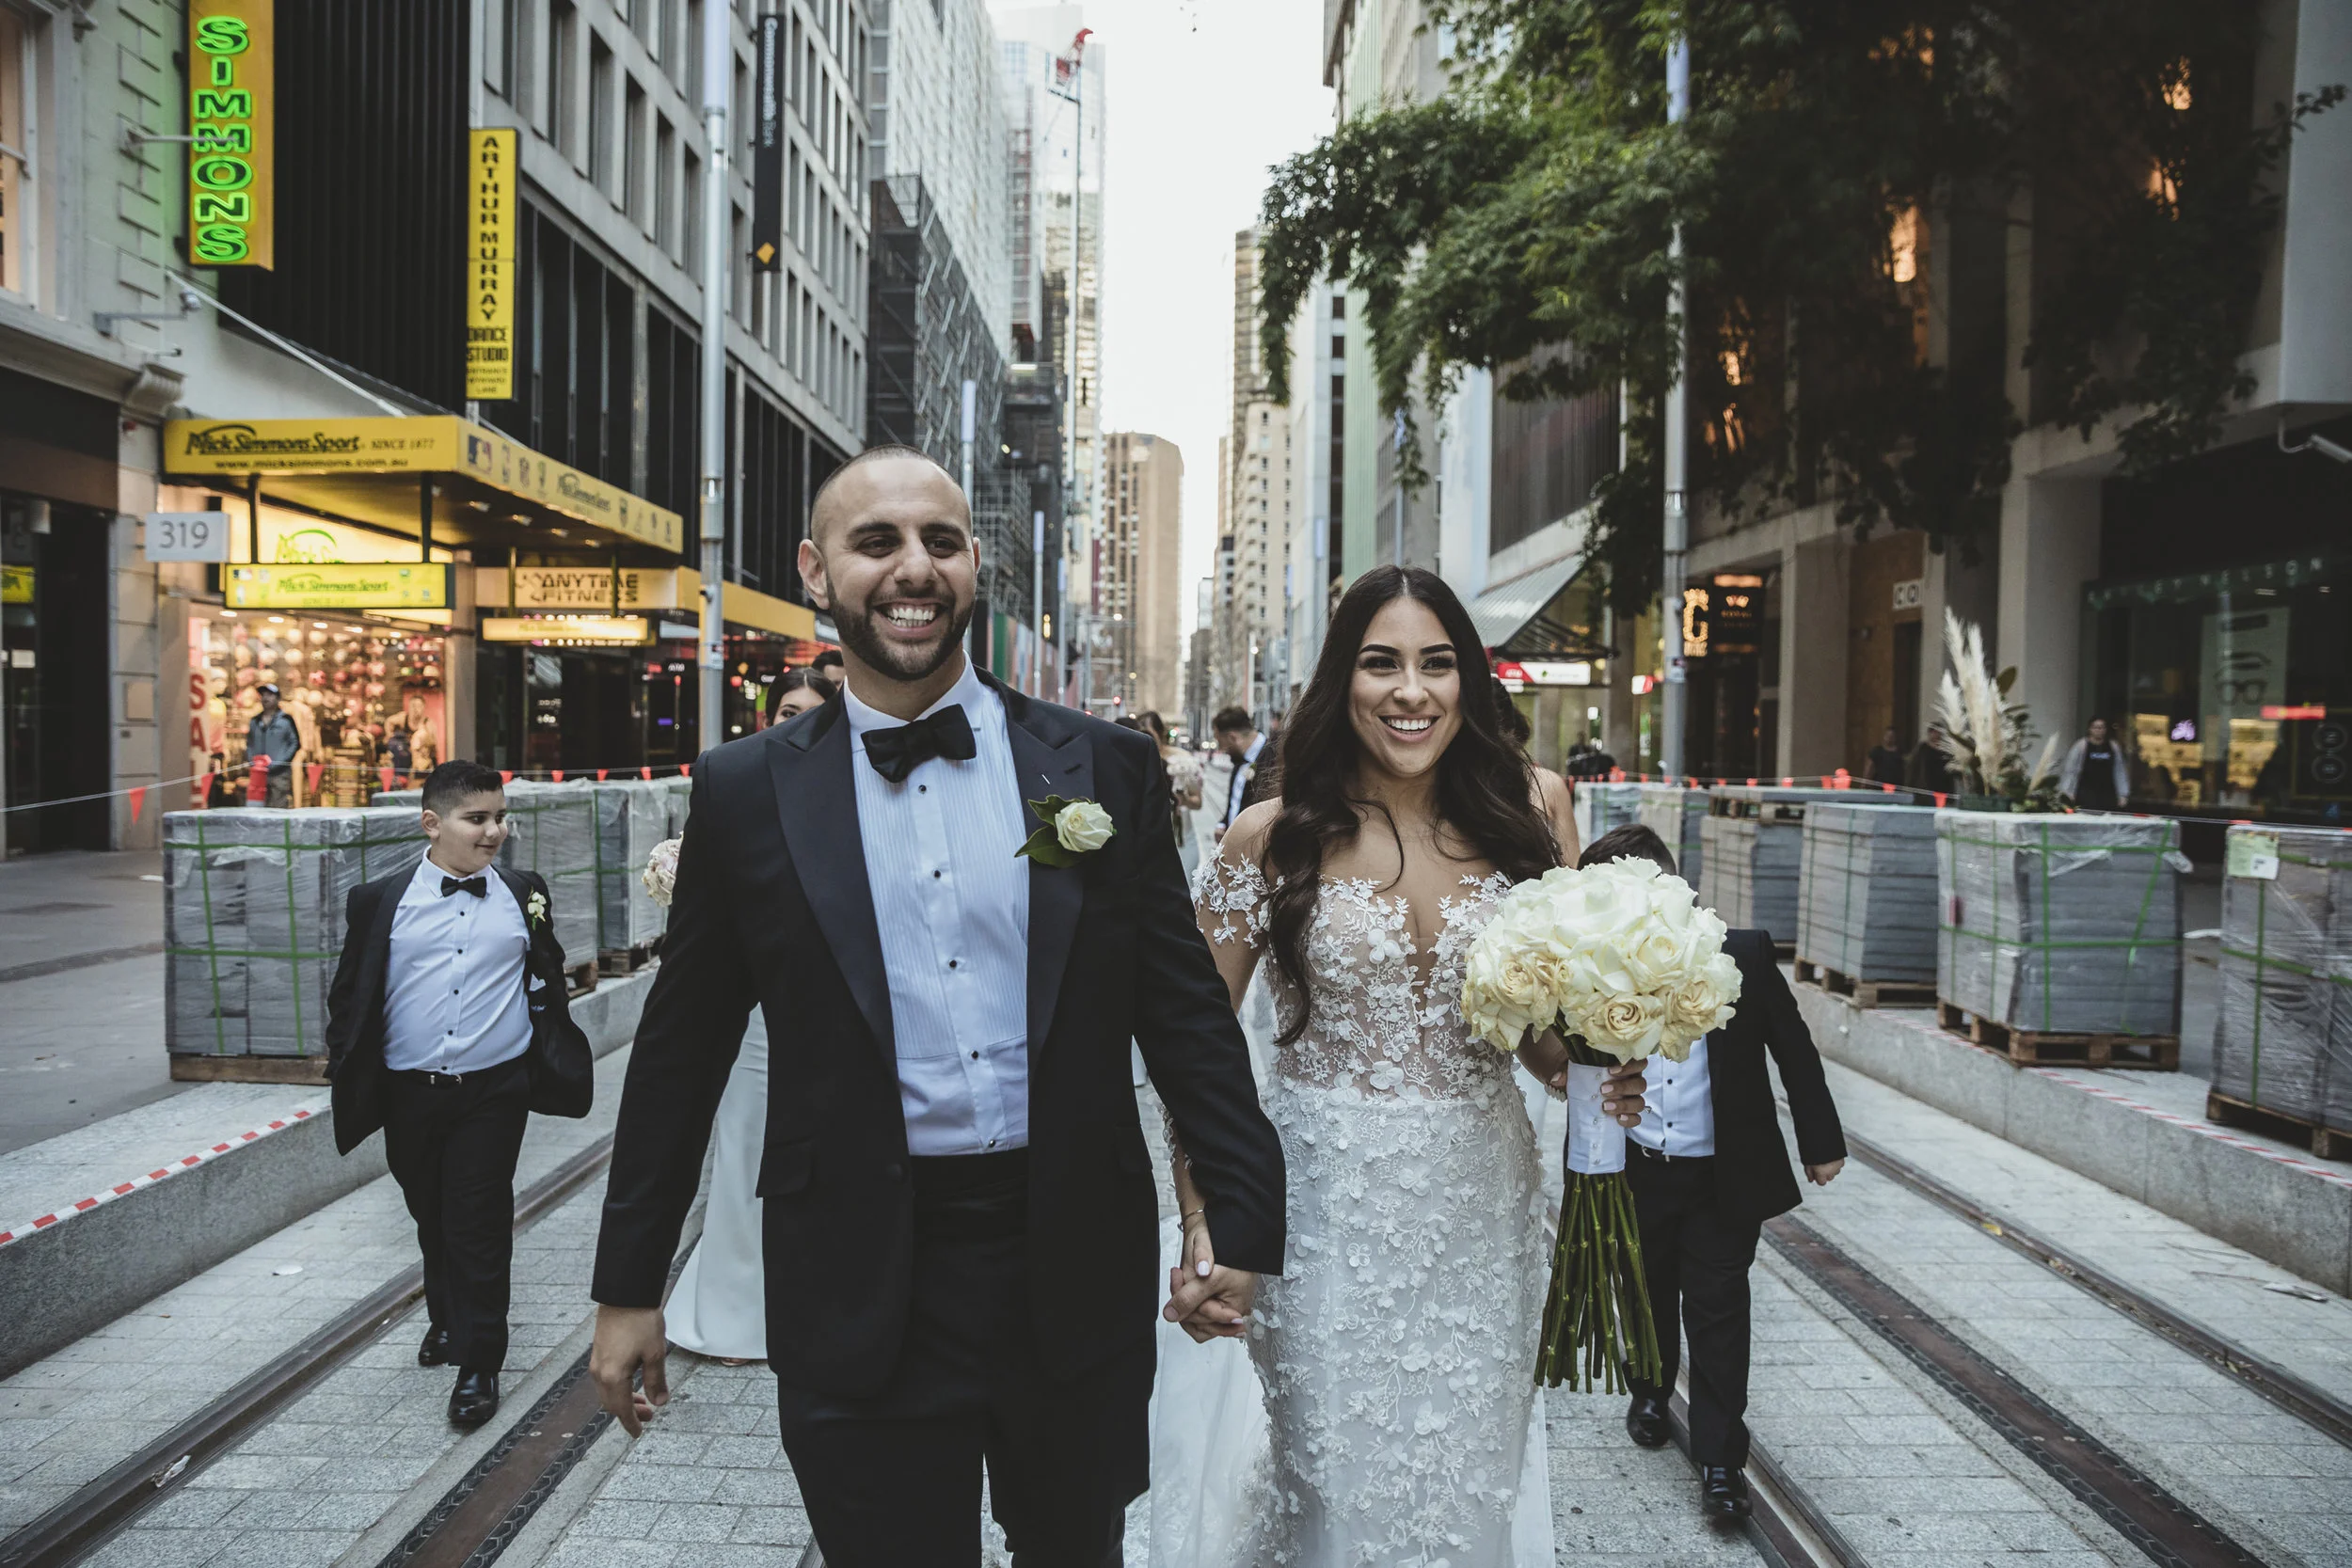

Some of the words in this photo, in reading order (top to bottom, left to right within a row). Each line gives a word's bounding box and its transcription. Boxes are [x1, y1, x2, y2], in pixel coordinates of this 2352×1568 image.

[192, 15, 252, 261] SIMMONS
[481, 136, 499, 225] ARTHUR
[480, 232, 498, 320] MURRAY
[469, 327, 507, 341] DANCE
[468, 347, 509, 361] STUDIO
[185, 428, 232, 454] Mick
[234, 433, 310, 453] Simmons
[312, 432, 359, 453] Sport
[371, 438, 405, 449] SINCE
[215, 459, 408, 468] www.micksimmons.com.au
[159, 520, 209, 548] 319
[543, 590, 638, 602] FITNES
[190, 674, 206, 809] SAL
